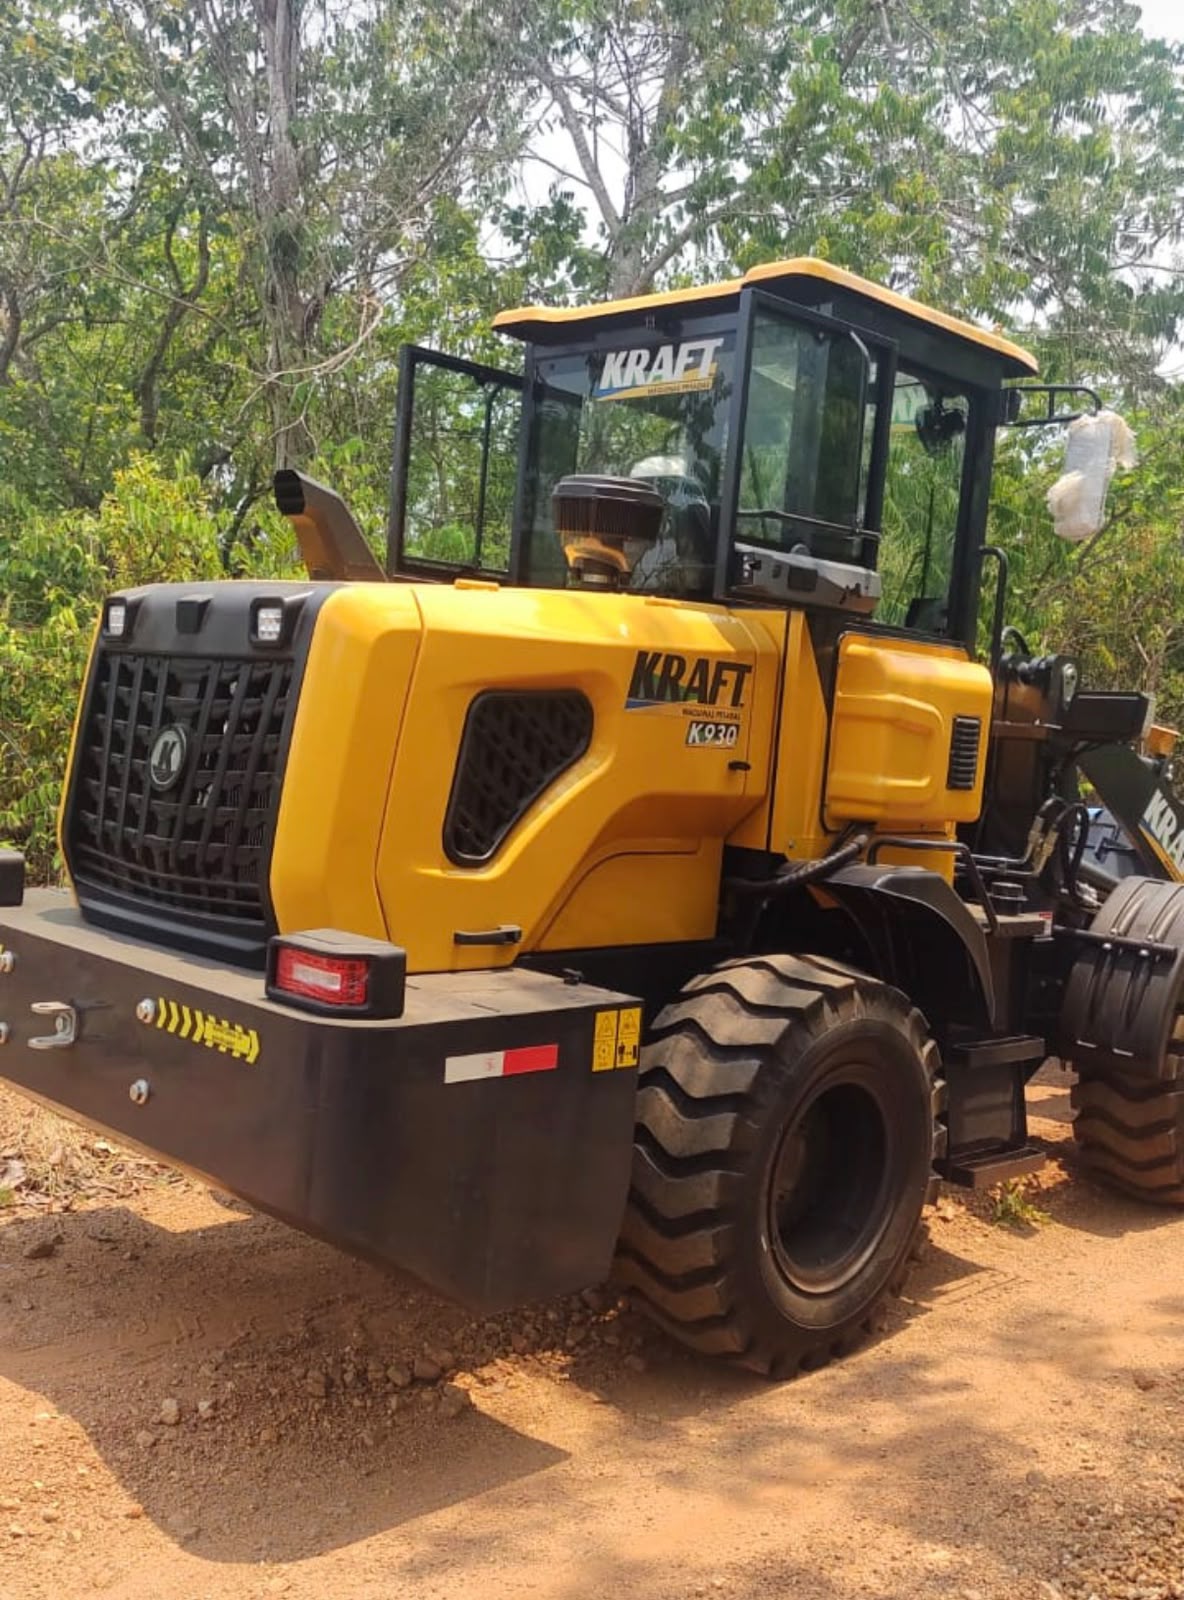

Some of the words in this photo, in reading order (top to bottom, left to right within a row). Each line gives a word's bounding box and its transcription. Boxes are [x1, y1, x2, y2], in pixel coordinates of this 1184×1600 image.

[599, 338, 724, 390] KRAFT
[627, 650, 752, 708] KRAFT
[687, 722, 737, 746] K930
